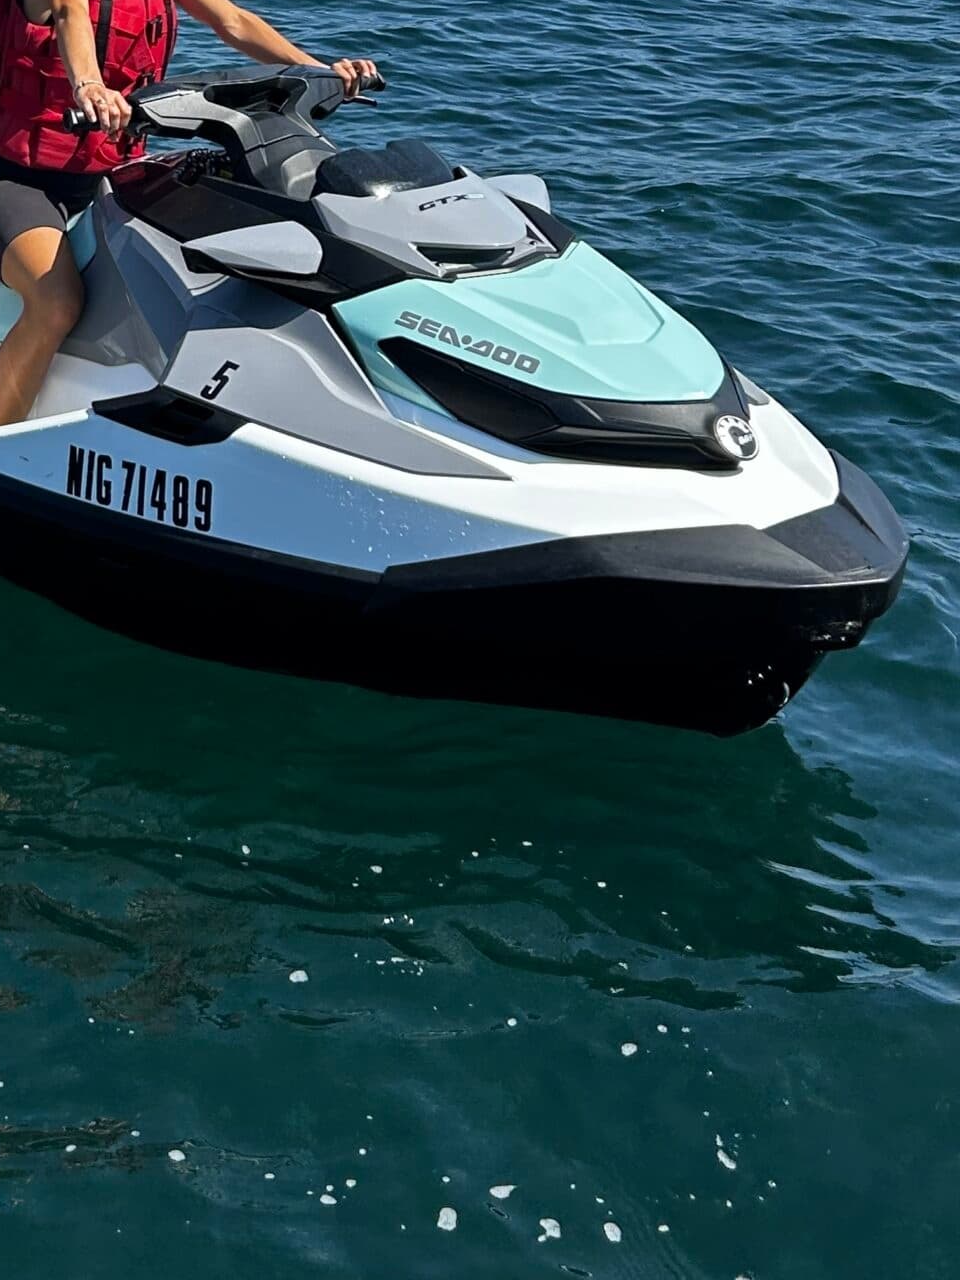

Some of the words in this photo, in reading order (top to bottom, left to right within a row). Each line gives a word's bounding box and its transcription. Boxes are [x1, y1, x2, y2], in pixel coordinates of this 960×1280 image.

[419, 194, 468, 211] GTX
[200, 359, 240, 400] 5
[66, 444, 113, 506] NIG
[121, 459, 213, 532] 71489
